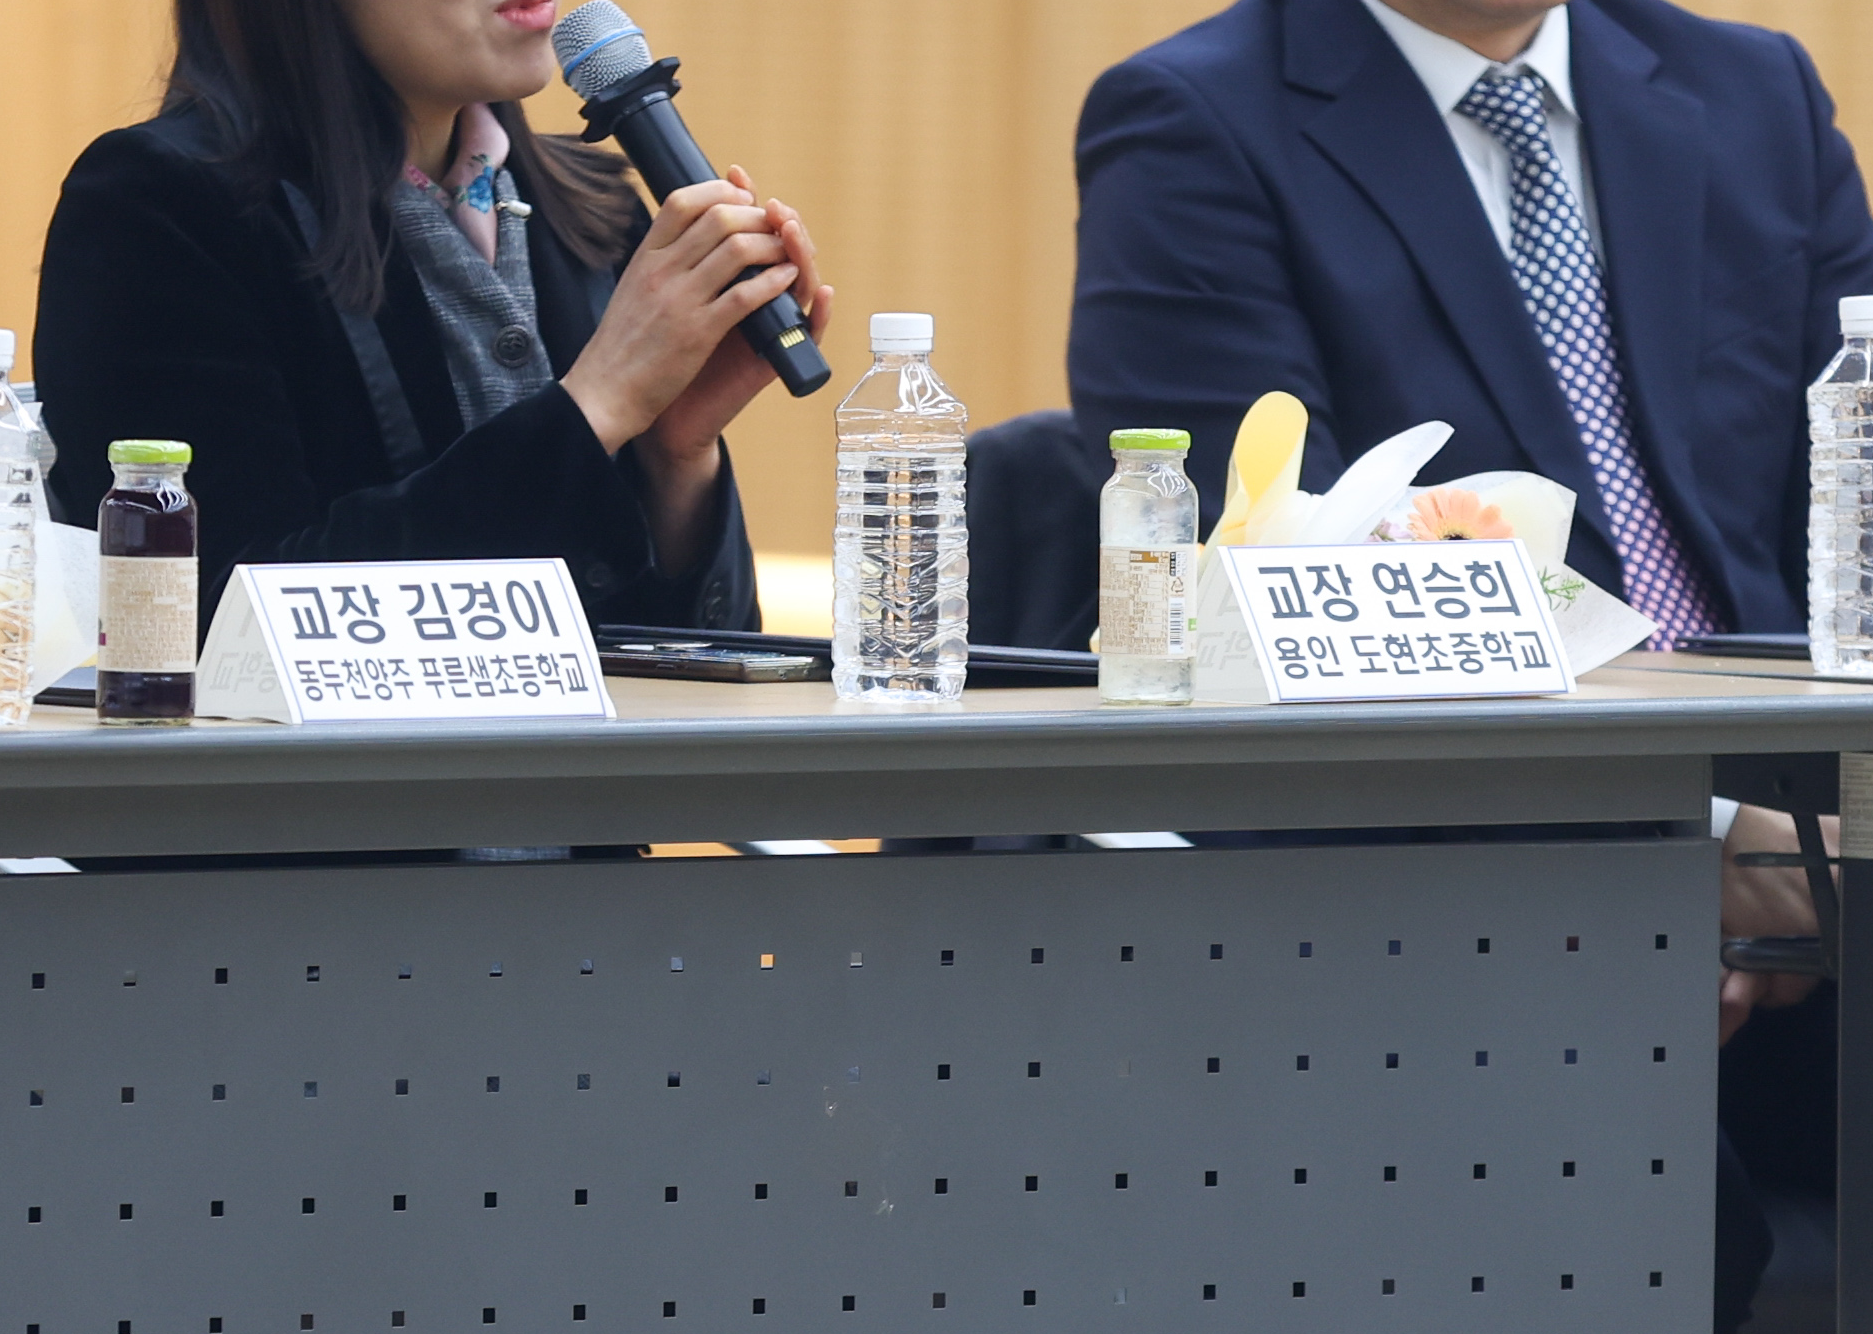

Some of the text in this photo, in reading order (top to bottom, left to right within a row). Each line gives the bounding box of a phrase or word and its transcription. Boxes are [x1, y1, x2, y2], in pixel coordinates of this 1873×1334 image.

[281, 580, 560, 644] 교장 김경이
[1258, 560, 1521, 622] 교장 연승희
[294, 658, 414, 701] 동두천양주
[418, 653, 589, 698] 푸른샘초등학교
[1274, 636, 1343, 680] 용인
[1351, 631, 1551, 675] 도현초중학교
